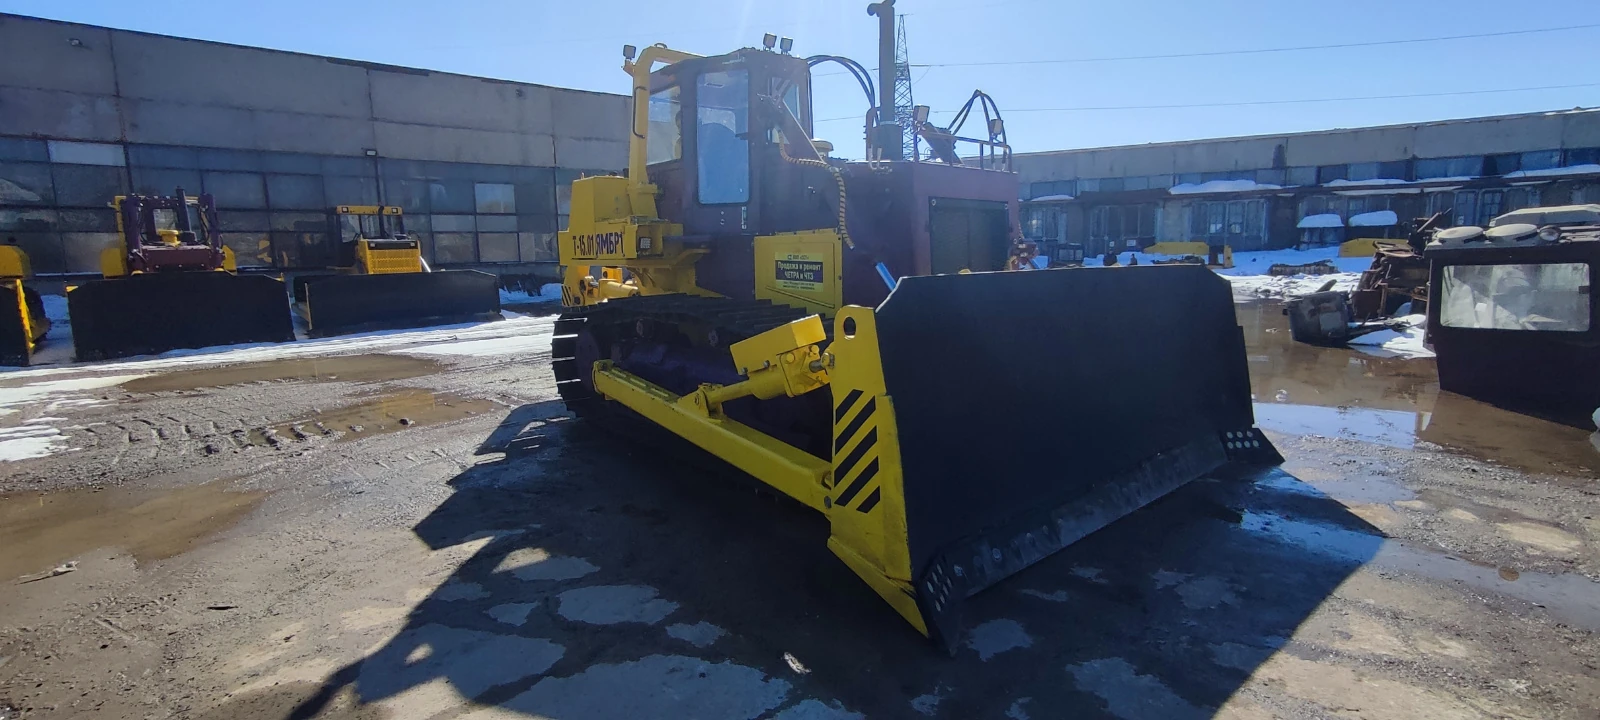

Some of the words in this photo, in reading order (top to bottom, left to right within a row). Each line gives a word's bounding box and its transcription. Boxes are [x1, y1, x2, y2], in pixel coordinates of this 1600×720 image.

[778, 262, 798, 270] Продажа
[784, 271, 800, 280] ЧЕТРА
[804, 272, 814, 280] ЧТЗ
